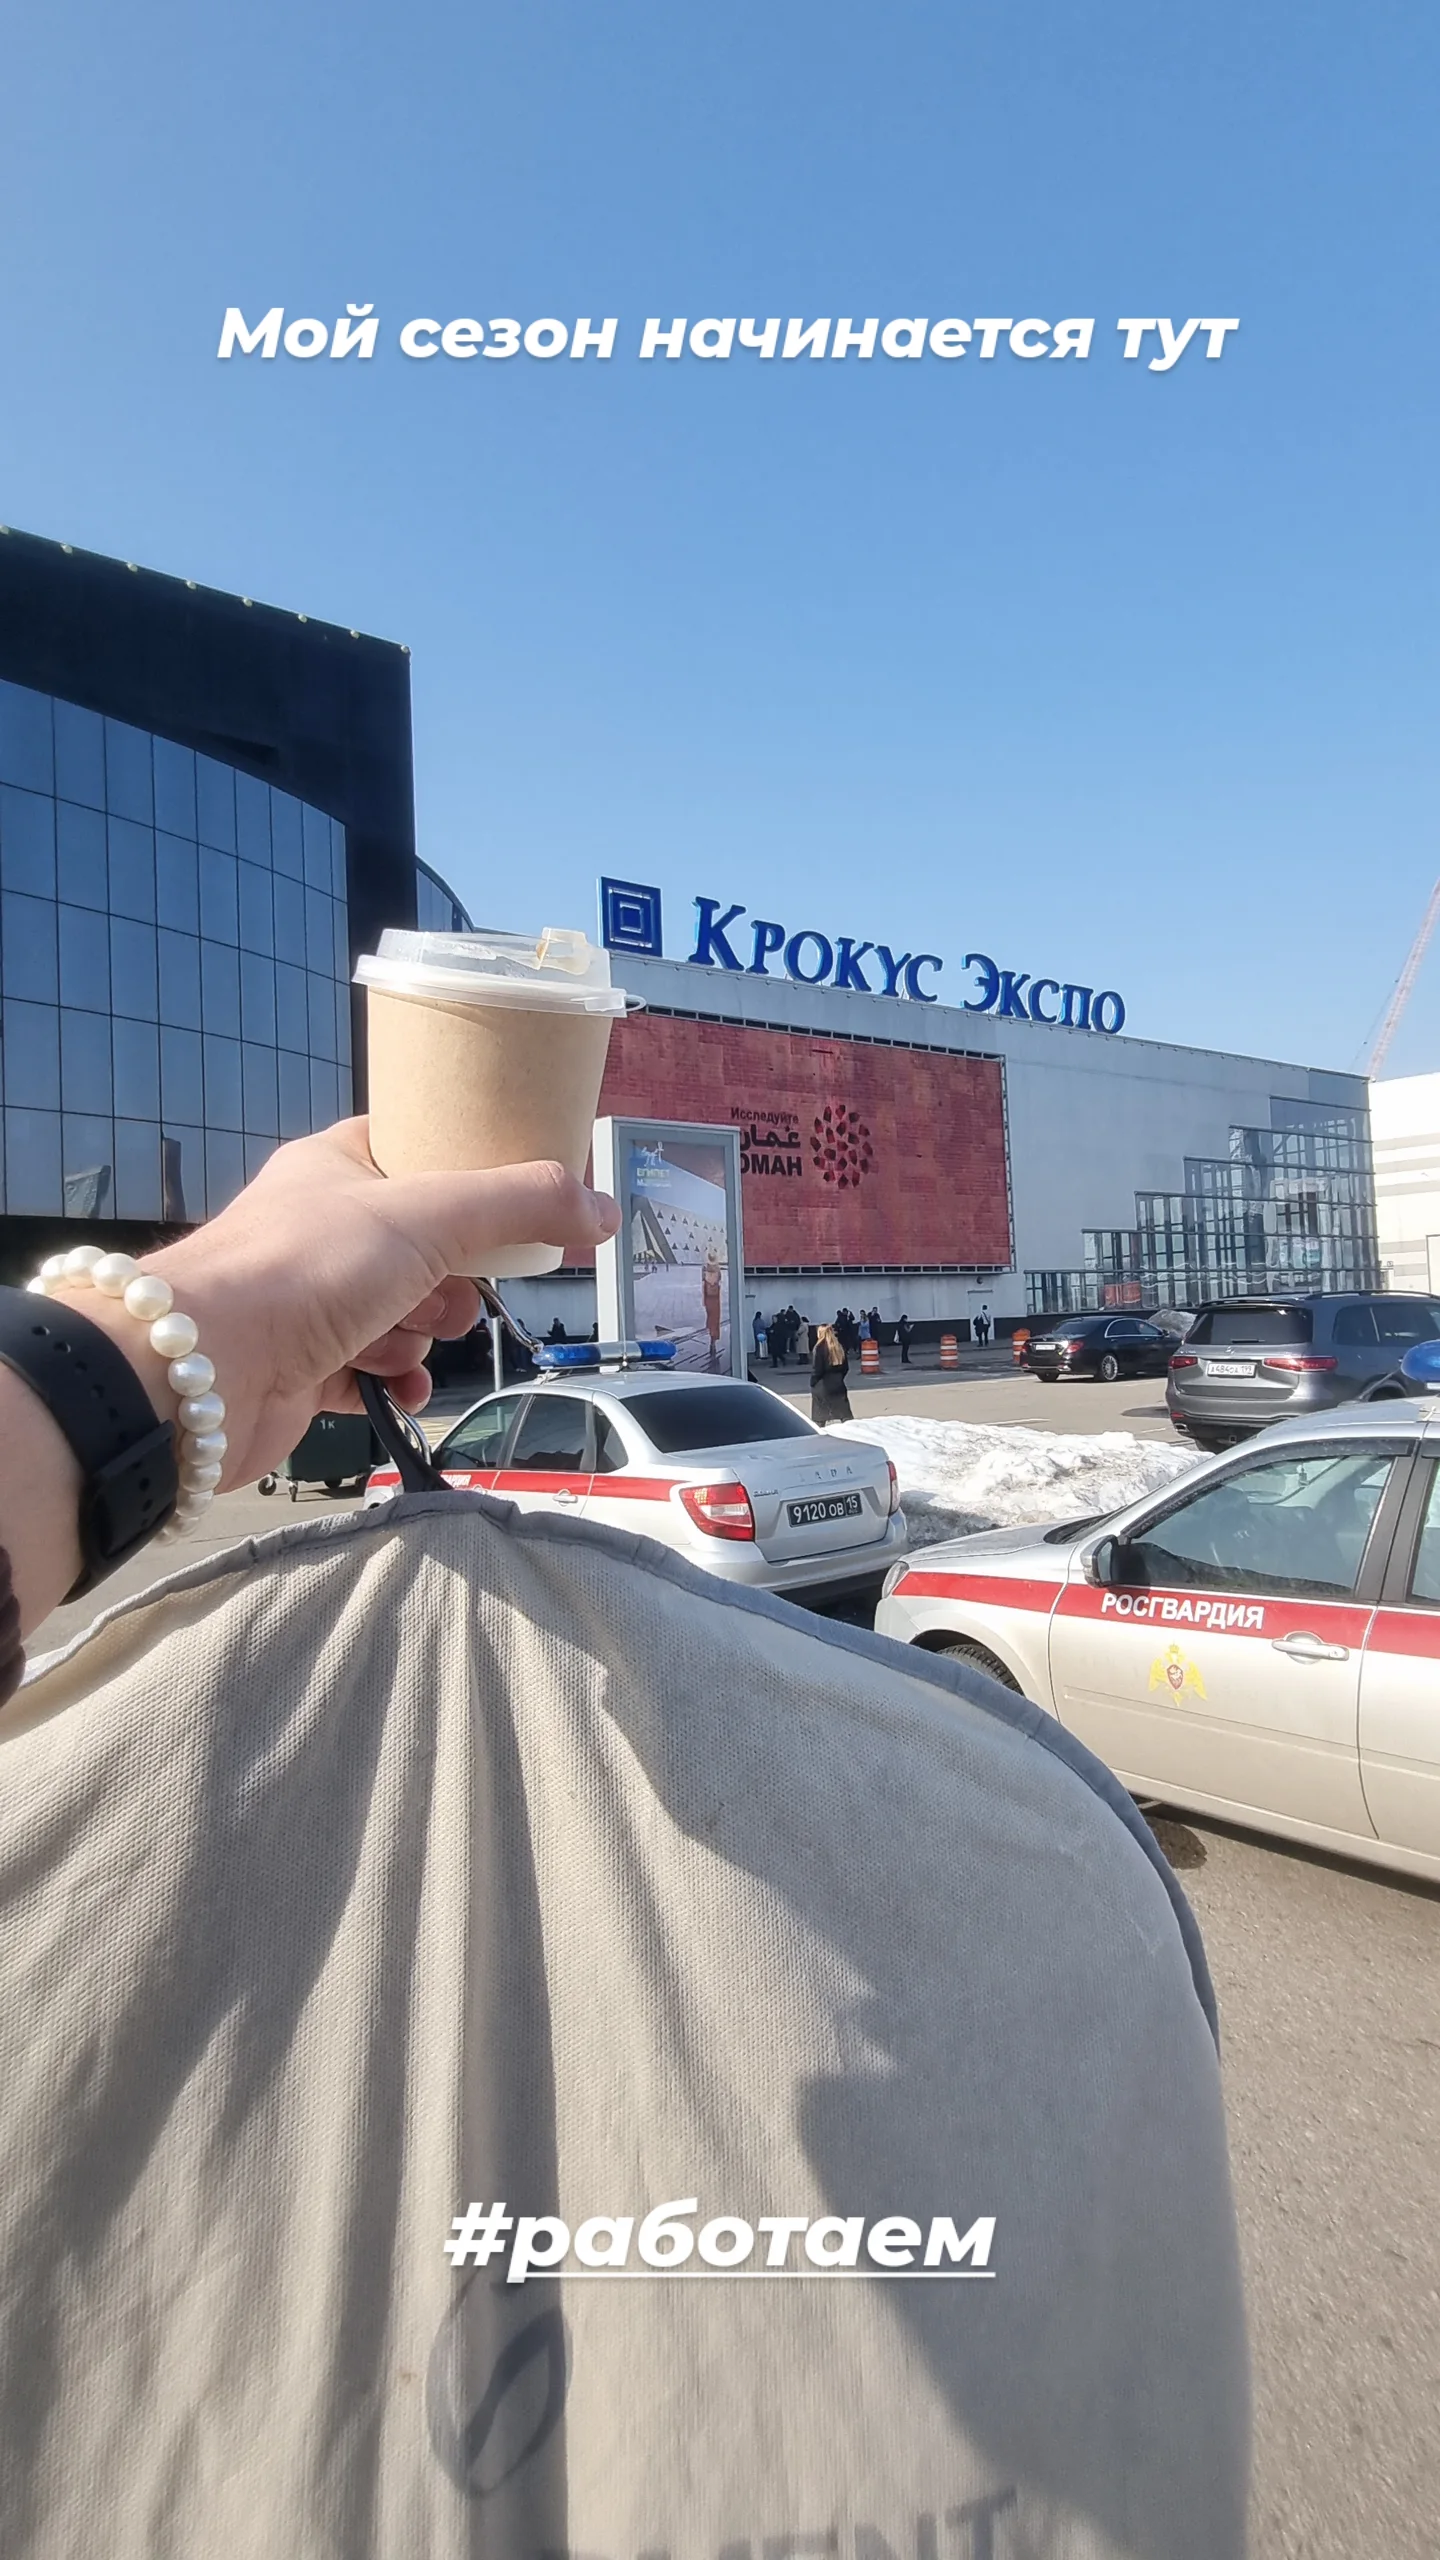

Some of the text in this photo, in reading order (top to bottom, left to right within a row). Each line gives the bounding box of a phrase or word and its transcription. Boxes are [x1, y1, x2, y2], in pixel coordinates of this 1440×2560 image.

[731, 1107, 799, 1126] Исследуйте
[792, 1502, 827, 1524] 9120
[846, 1495, 859, 1509] 15
[1101, 1592, 1265, 1630] РОСГВАРДИЯ
